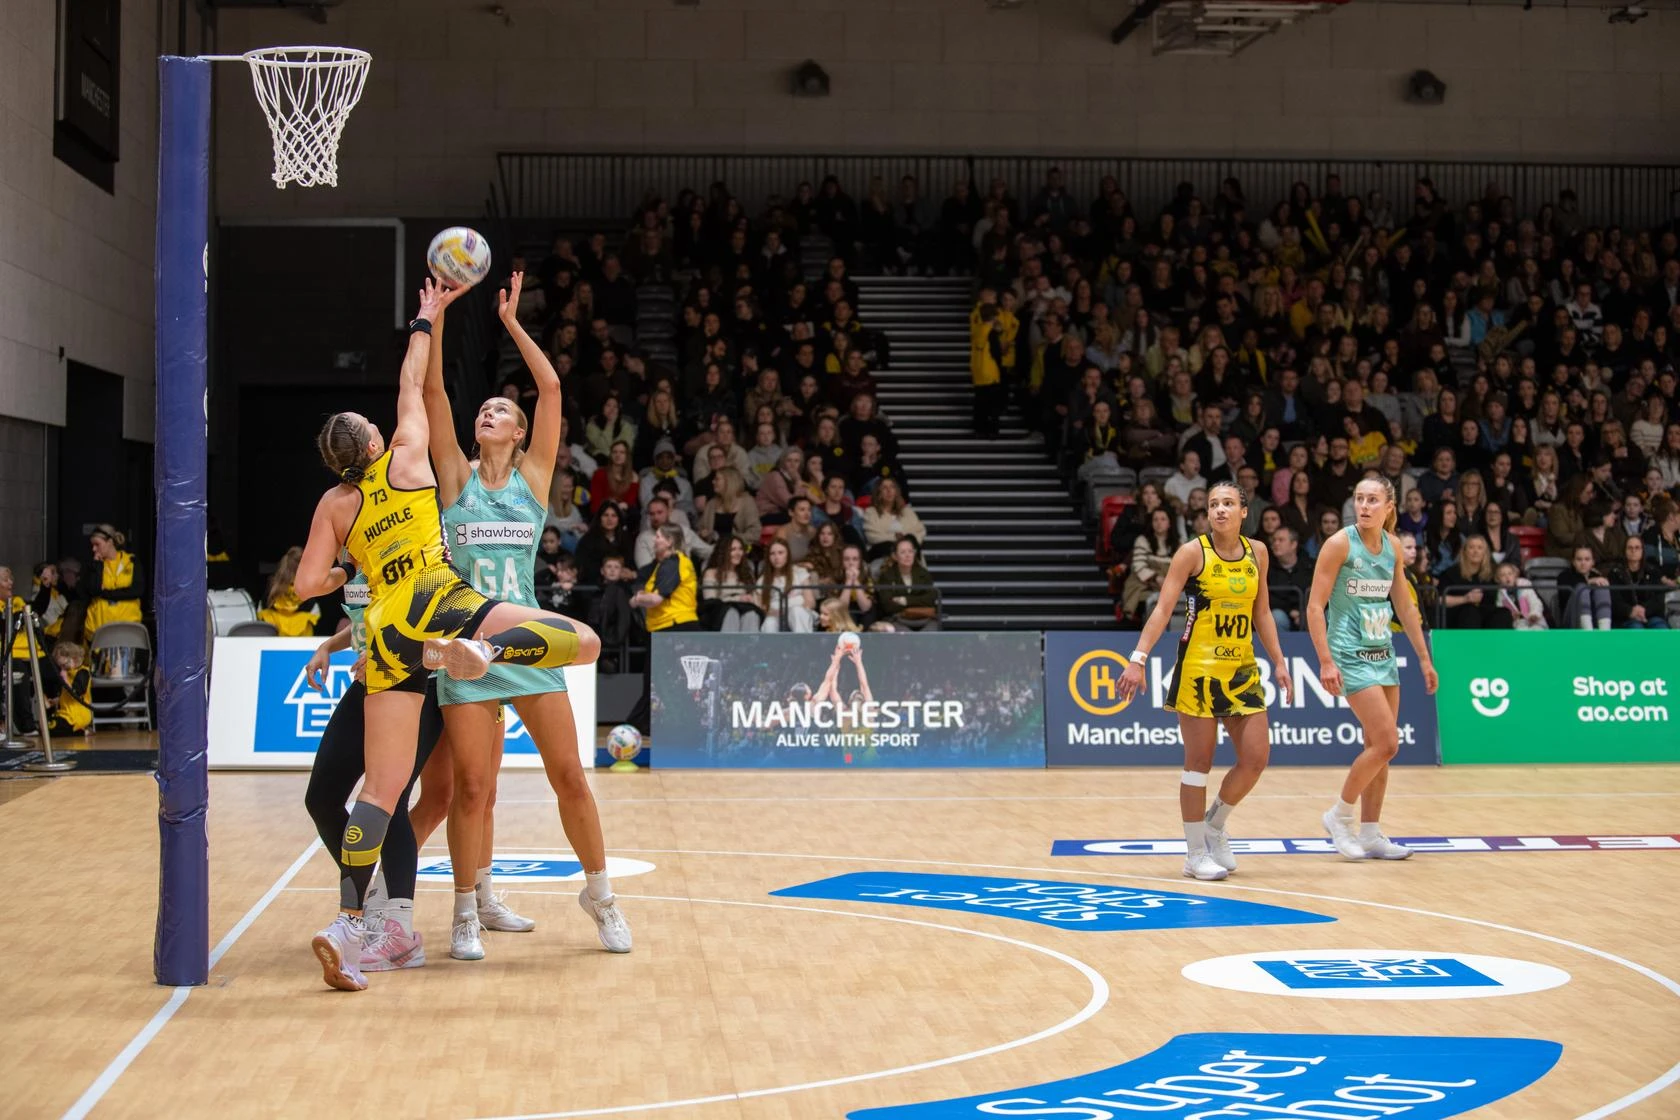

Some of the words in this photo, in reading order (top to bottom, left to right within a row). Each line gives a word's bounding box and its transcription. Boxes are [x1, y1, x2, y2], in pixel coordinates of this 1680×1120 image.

[370, 489, 388, 505] 73
[364, 507, 413, 542] HUCKLE
[471, 527, 533, 538] shawbrook
[474, 557, 522, 599] GA
[1215, 614, 1249, 639] WD
[1469, 678, 1510, 698] ao
[1573, 676, 1635, 701] Shop
[1640, 678, 1668, 696] at
[732, 701, 964, 728] MANCHESTER
[1577, 705, 1669, 722] ao.com
[776, 733, 820, 747] ALIVE
[825, 733, 865, 747] WITH
[870, 733, 920, 747] SPORT
[858, 888, 1147, 922] Super
[984, 883, 1207, 909] Shot
